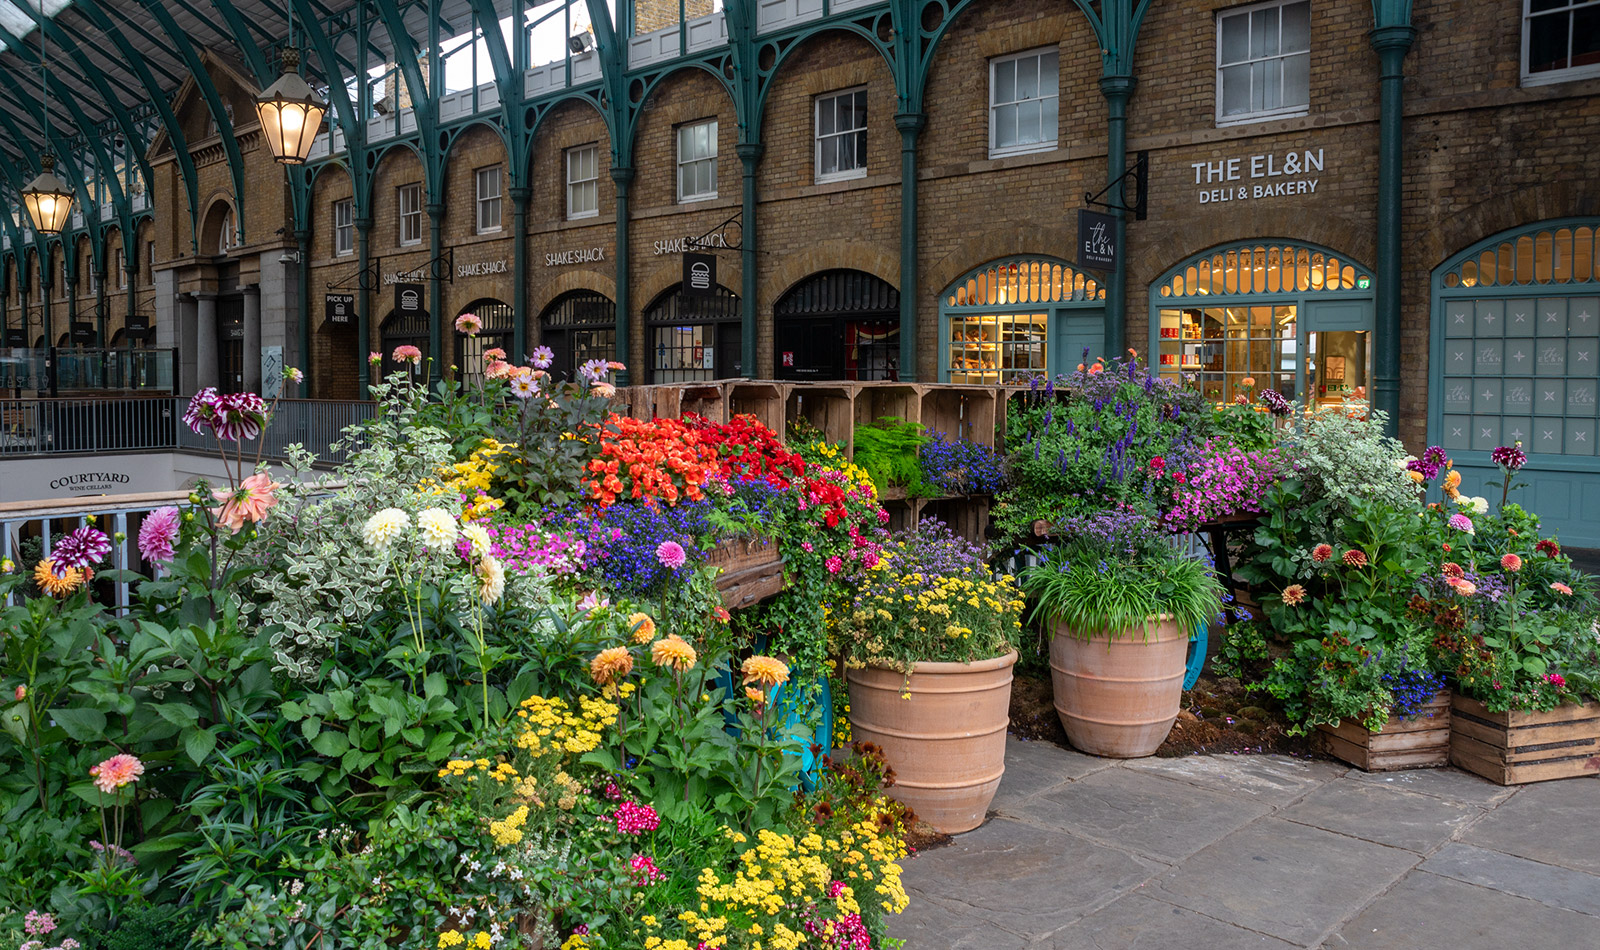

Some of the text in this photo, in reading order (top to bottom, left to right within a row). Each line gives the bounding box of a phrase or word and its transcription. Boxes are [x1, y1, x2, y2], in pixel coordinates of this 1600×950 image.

[1191, 148, 1324, 184] THE EL&N
[1199, 179, 1319, 204] DELI & BAKERY
[1090, 221, 1110, 245] the
[653, 239, 688, 255] SHAKE
[545, 247, 605, 267] SHAKE SHACK
[457, 259, 507, 278] SHAKE SHACK
[326, 295, 342, 303] PICK
[332, 315, 348, 323] HERE
[50, 472, 130, 490] COURTYARD
